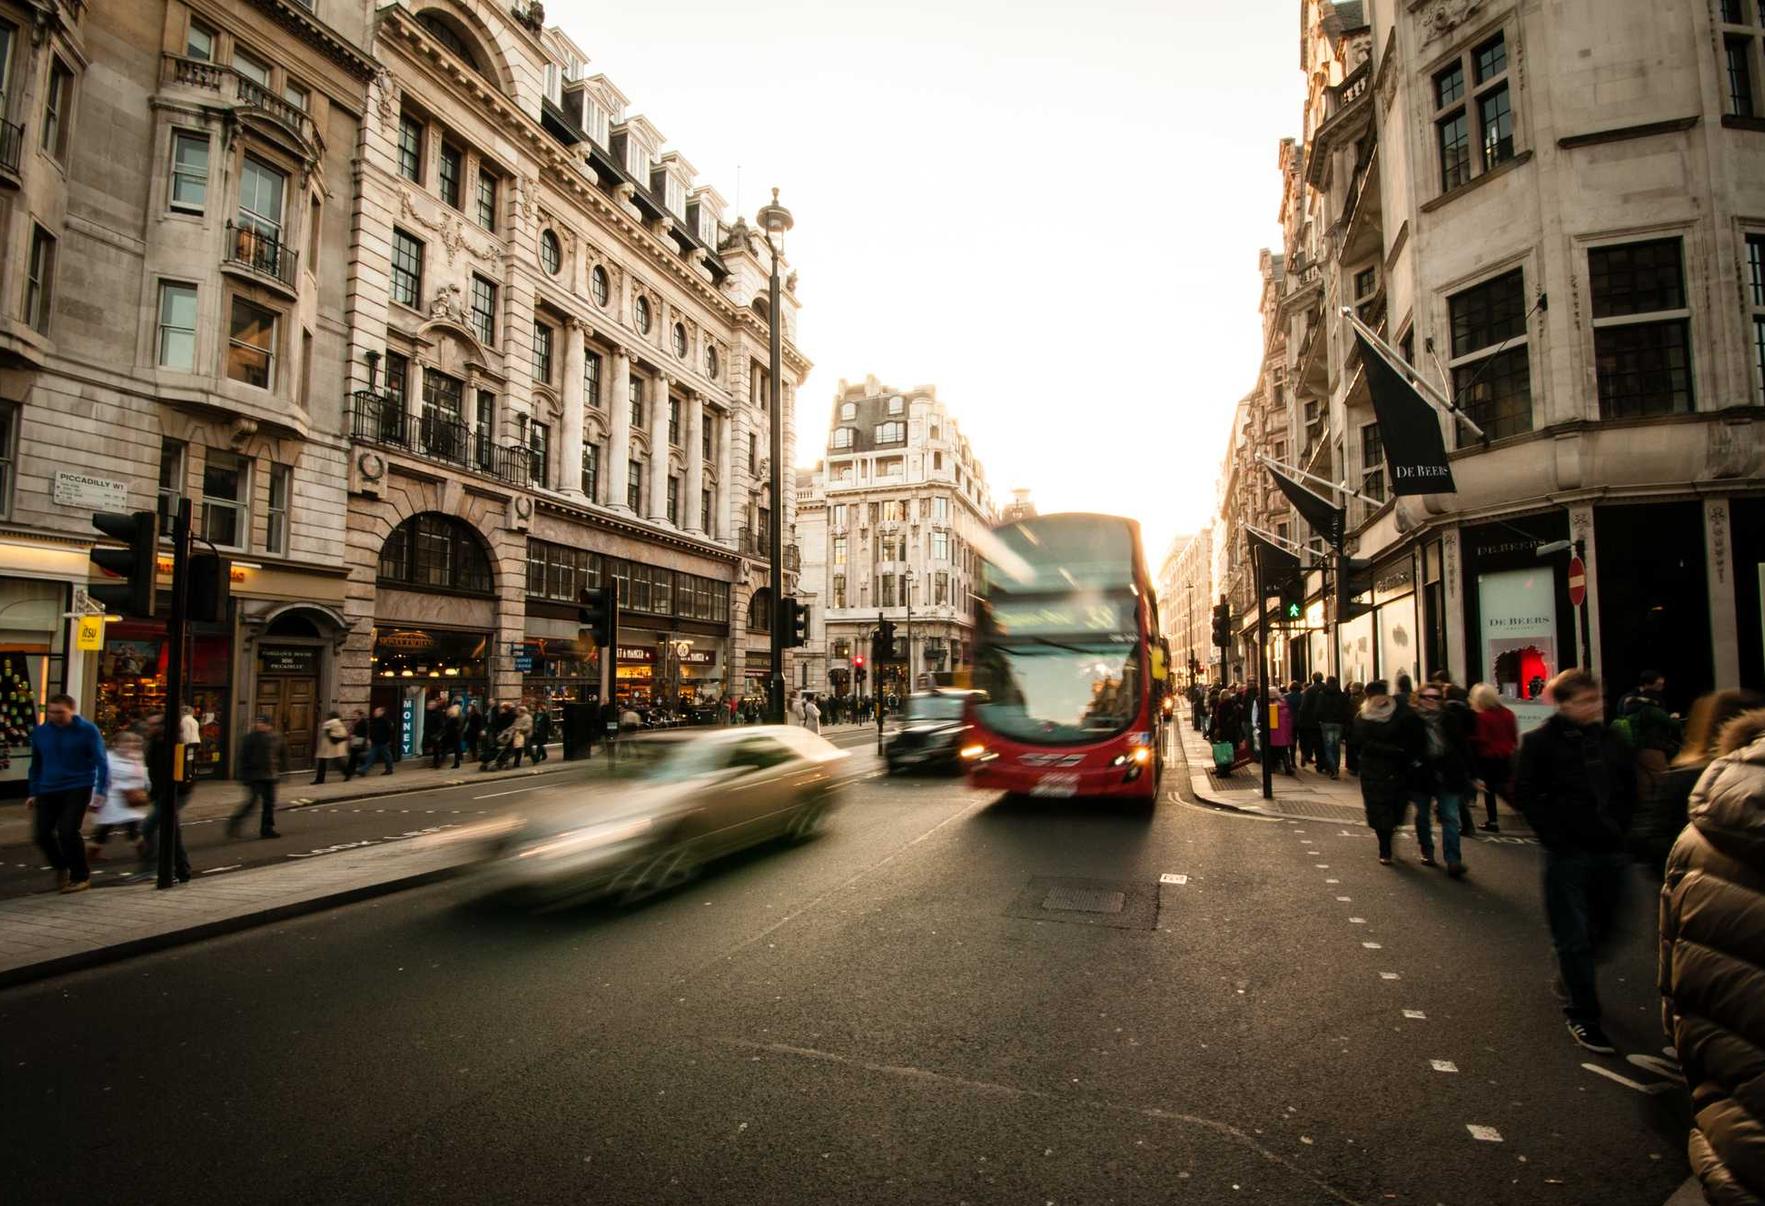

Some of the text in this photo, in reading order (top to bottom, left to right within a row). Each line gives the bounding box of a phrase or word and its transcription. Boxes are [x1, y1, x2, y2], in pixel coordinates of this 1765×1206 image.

[1396, 466, 1415, 478] DE
[60, 473, 124, 491] PICCADILLY W1
[1489, 616, 1550, 626] DE BEERS
[403, 700, 412, 753] MONEY
